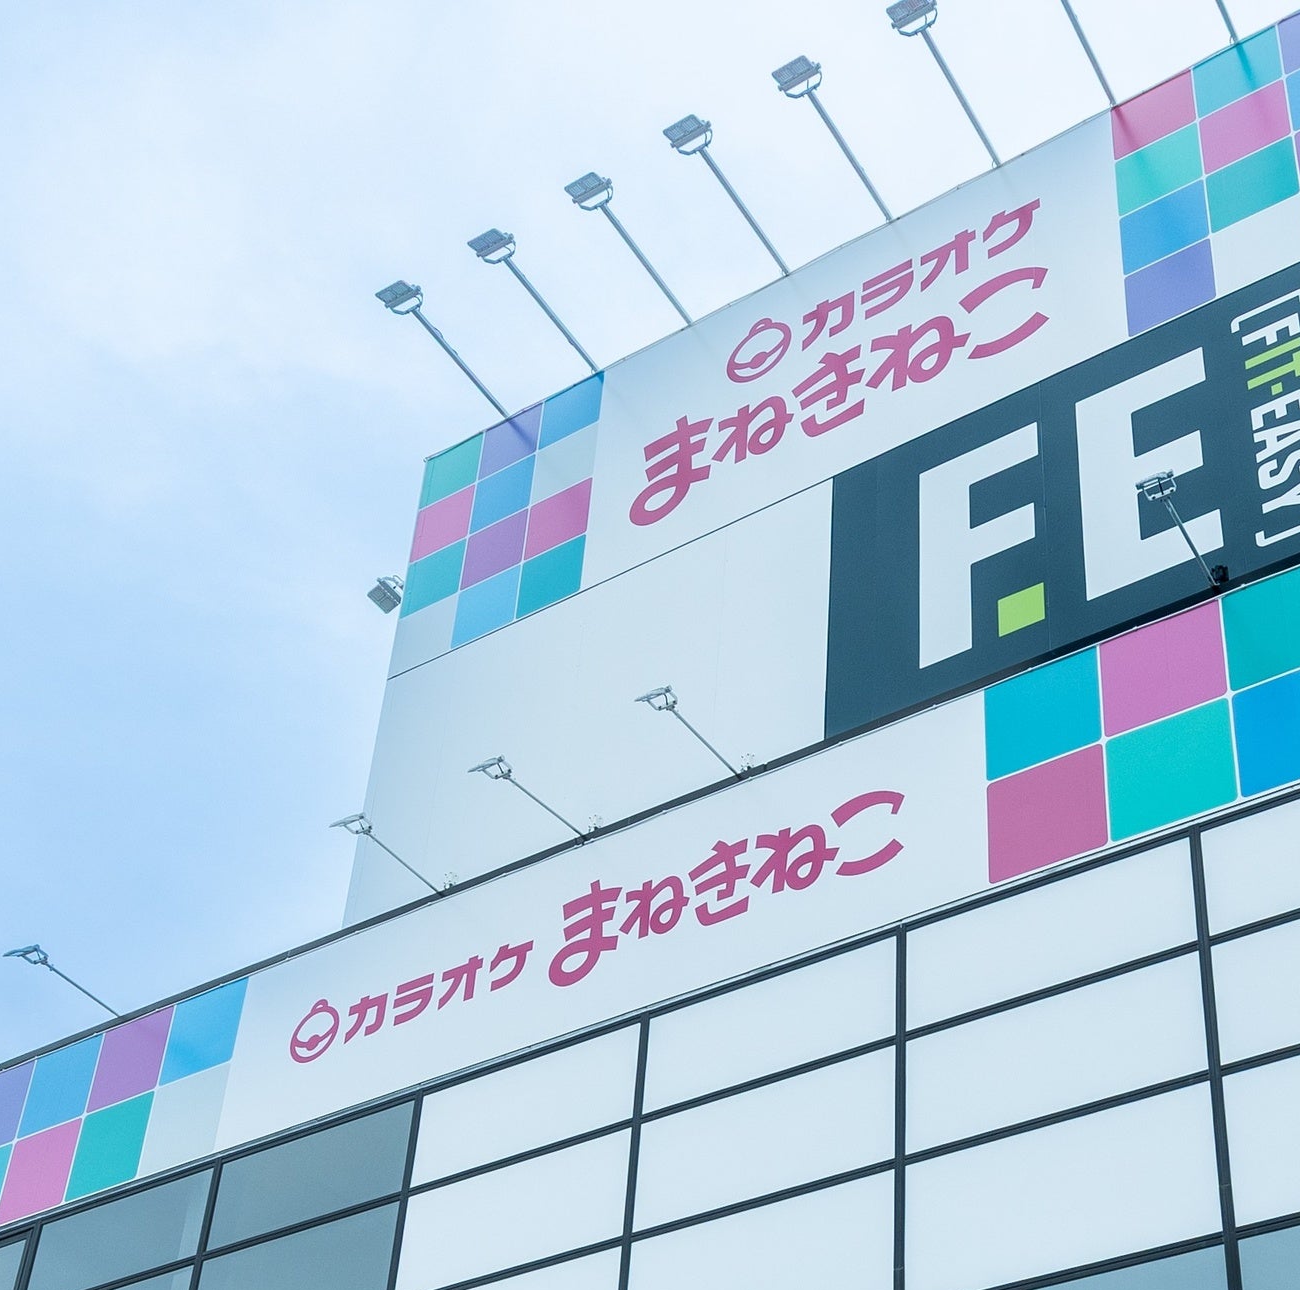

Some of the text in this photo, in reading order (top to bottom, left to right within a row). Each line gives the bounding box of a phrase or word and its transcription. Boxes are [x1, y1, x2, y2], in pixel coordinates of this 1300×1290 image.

[629, 266, 1049, 527] まねきねこ
[801, 197, 1041, 349] カラオケ
[344, 789, 906, 1045] カラオケ まねきねこ
